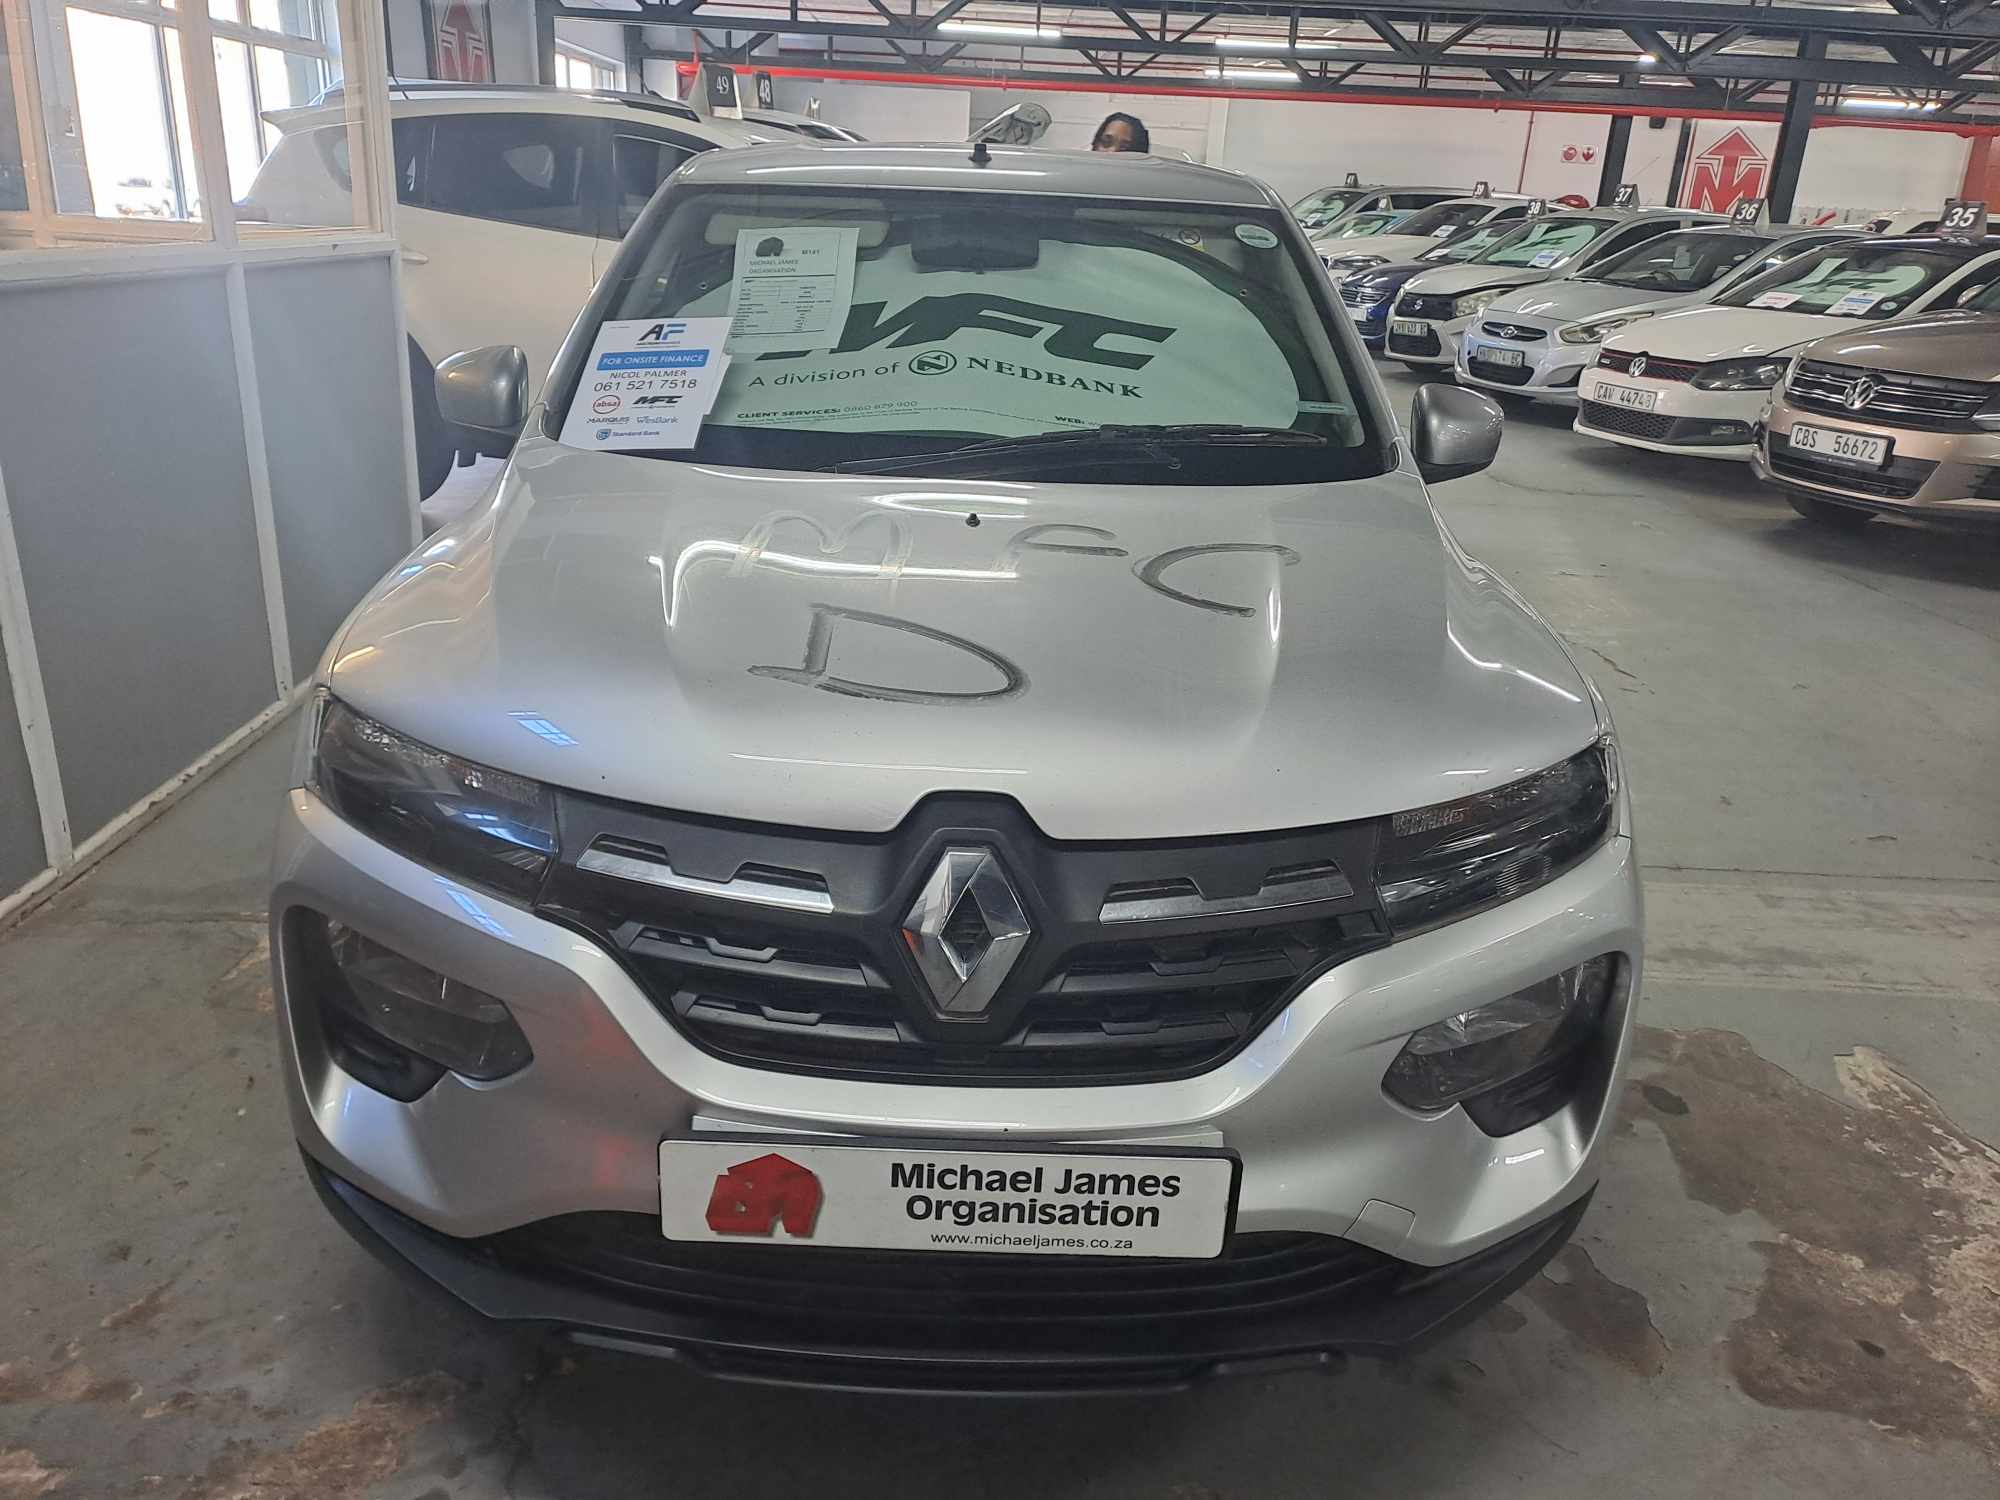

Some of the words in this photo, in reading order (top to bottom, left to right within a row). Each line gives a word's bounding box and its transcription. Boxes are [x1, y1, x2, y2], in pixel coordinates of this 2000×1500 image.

[715, 75, 729, 95] 49
[759, 79, 771, 103] 48
[1614, 187, 1633, 202] 37
[1527, 201, 1541, 215] 38
[1735, 203, 1759, 220] 36
[1944, 207, 1981, 228] 35
[638, 323, 688, 341] AF
[602, 357, 624, 366] FOR
[624, 355, 658, 365] ONSITE
[659, 354, 705, 363] FINANCE
[643, 369, 688, 378] PALMER
[748, 376, 765, 387] A
[774, 366, 866, 386] division
[875, 361, 901, 375] of
[966, 356, 1145, 399] NEDBANK
[594, 381, 620, 392] 061
[626, 380, 653, 390] 521
[660, 378, 697, 389] 7518
[736, 411, 779, 419] CLIENT
[781, 408, 841, 416] SERVICES:
[1794, 427, 1819, 448] CBS
[1833, 434, 1879, 460] 56672
[890, 1162, 1044, 1193] Michael
[1054, 1168, 1181, 1198] James
[905, 1194, 1160, 1228] Organisation
[930, 1233, 1133, 1250] www.michaeljames.co.za
